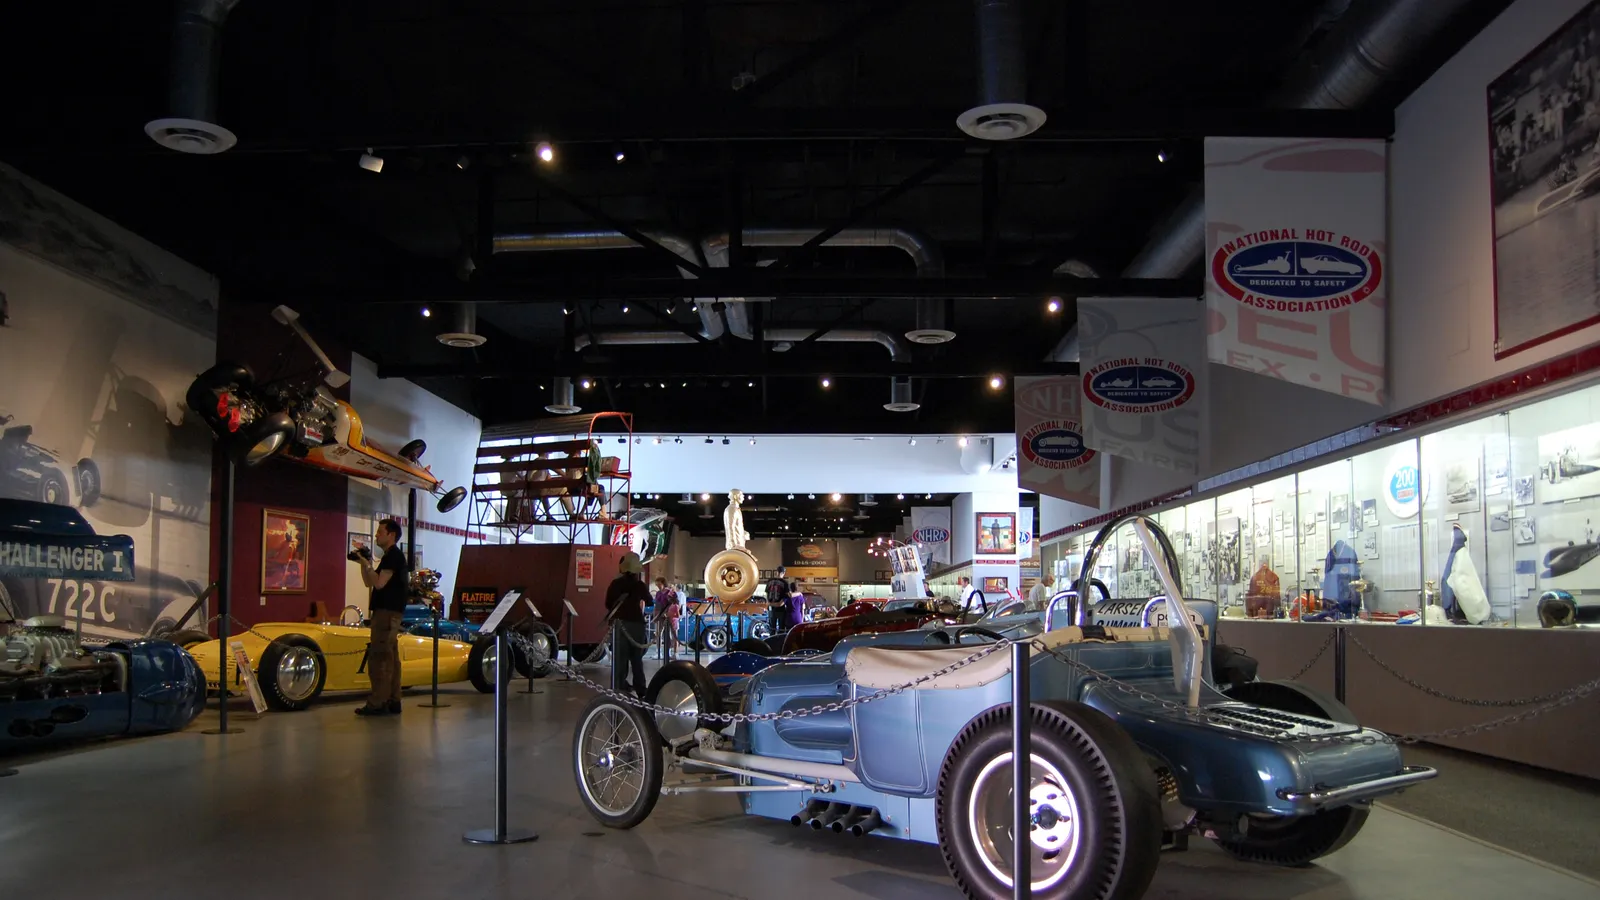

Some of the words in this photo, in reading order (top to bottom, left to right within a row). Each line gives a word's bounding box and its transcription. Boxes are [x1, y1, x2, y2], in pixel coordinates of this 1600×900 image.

[1225, 228, 1299, 254] NATIONAL
[1305, 228, 1335, 243] HOT
[1340, 235, 1371, 257] ROD
[1249, 279, 1296, 287] DEDICATED
[1242, 294, 1353, 313] ASSOCIATION
[1089, 357, 1140, 376] NATIONAL
[1144, 357, 1164, 367] HOT
[1167, 361, 1188, 376] ROD
[1102, 401, 1177, 414] ASSOCIATION
[1026, 420, 1060, 440] NATIONAL
[1063, 420, 1078, 432] HOT
[1034, 457, 1083, 470] ASSOCIATION
[1395, 467, 1415, 488] 200
[918, 529, 945, 542] NHRA
[0, 541, 104, 572] HALLENGER
[112, 550, 124, 572] I
[48, 578, 116, 623] 722C
[461, 592, 496, 602] FLATFIRE
